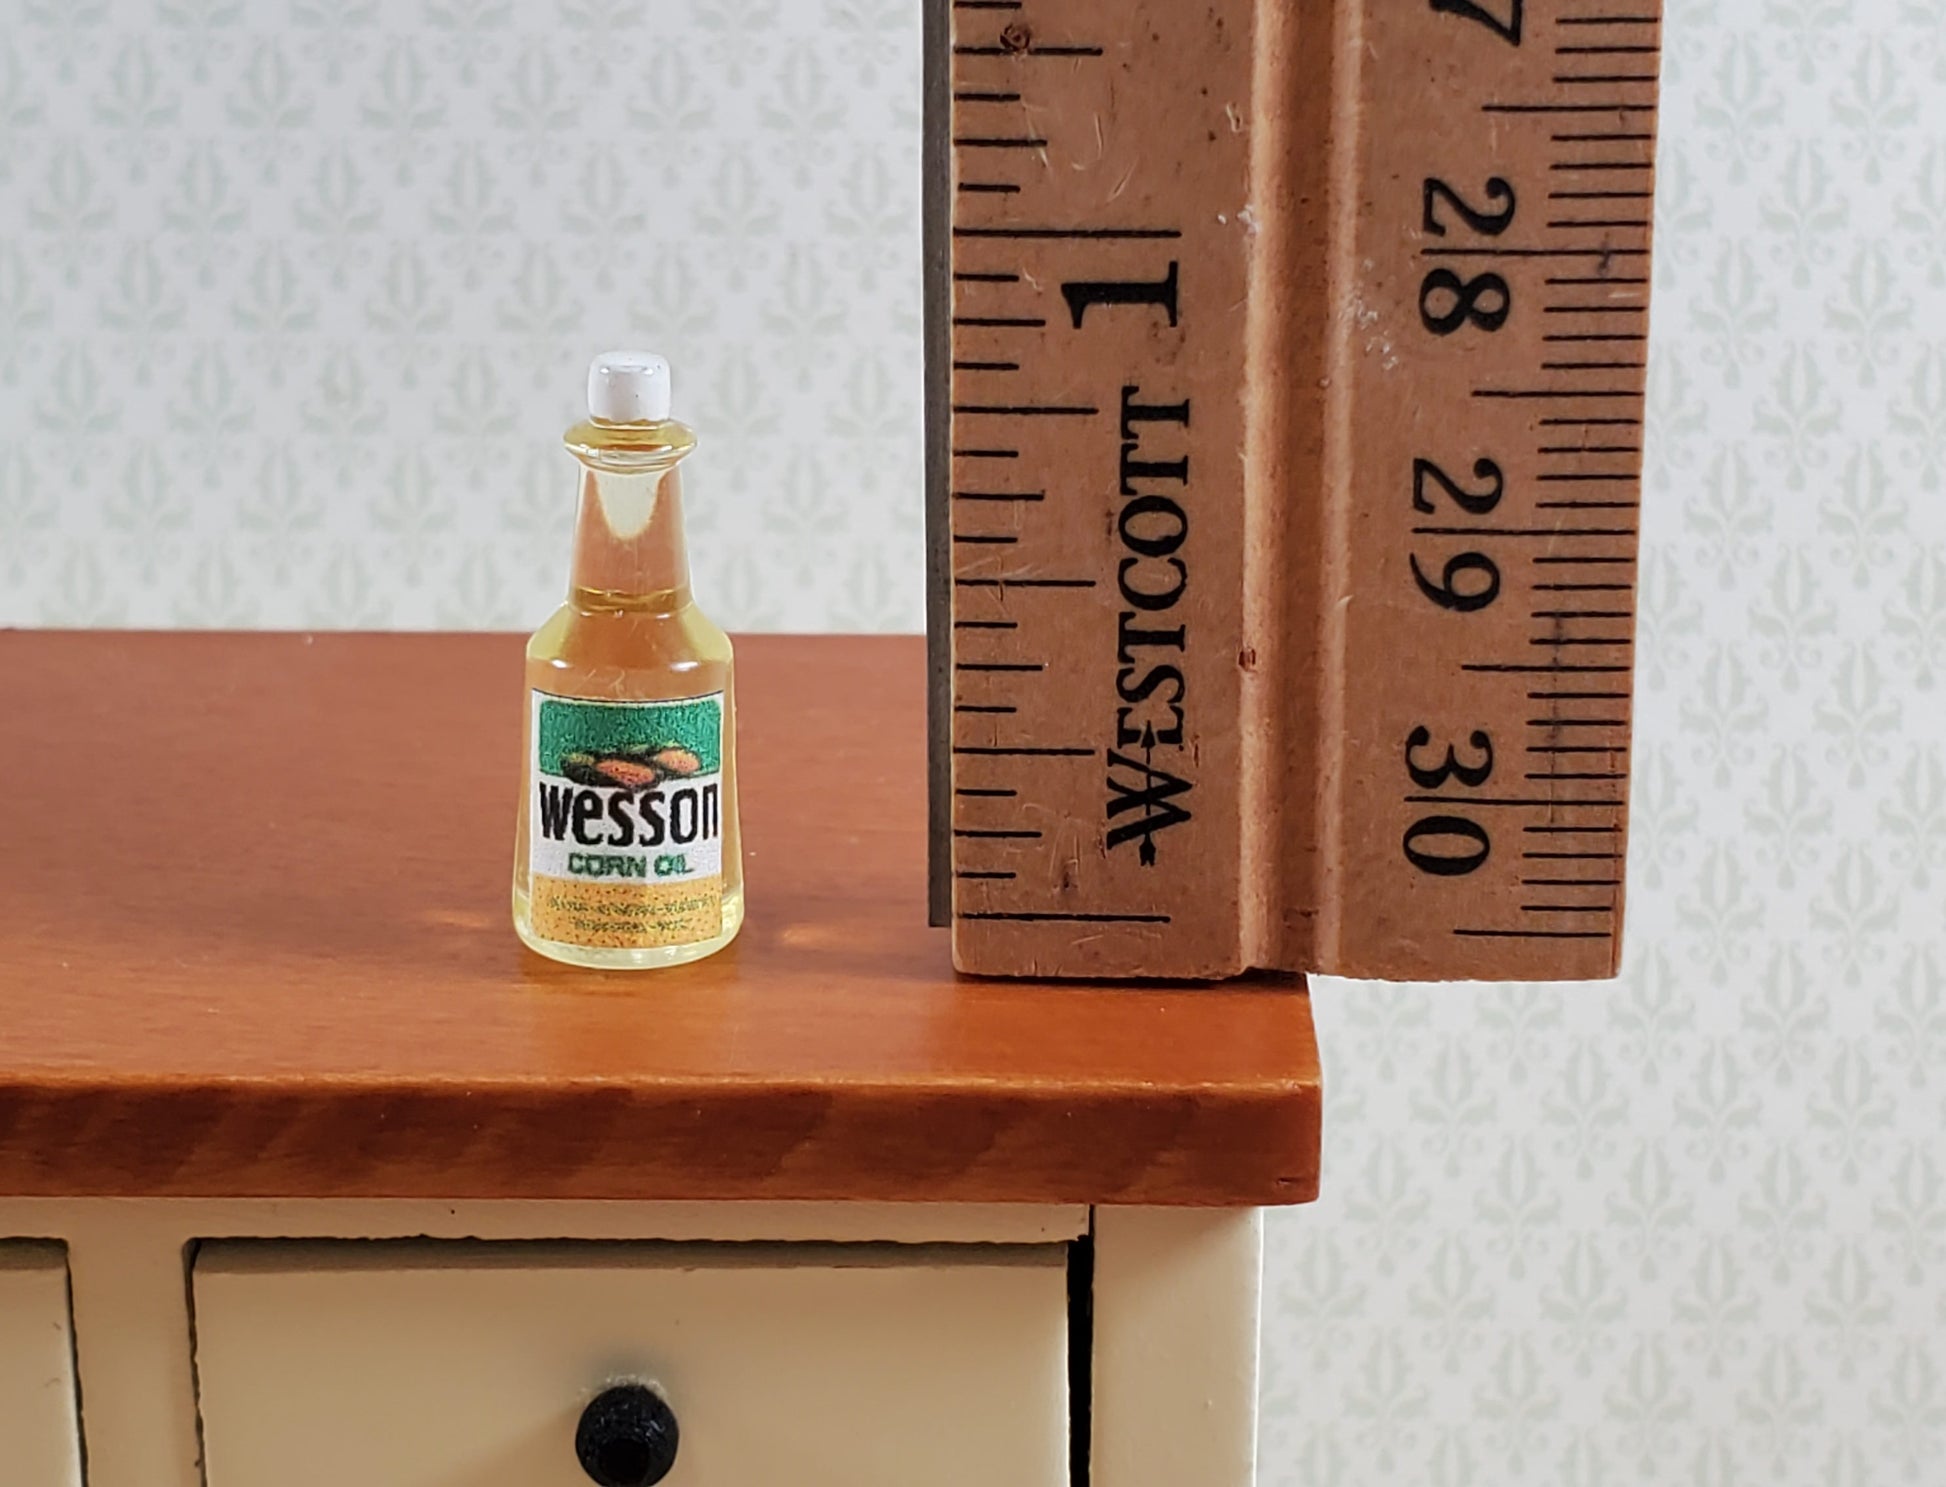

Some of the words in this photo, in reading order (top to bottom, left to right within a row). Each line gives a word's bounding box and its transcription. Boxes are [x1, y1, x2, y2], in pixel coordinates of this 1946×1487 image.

[1061, 260, 1179, 329] 1
[1419, 177, 1516, 336] 28
[1408, 457, 1504, 612] 29
[1107, 385, 1194, 849] WESTCOTT
[567, 853, 647, 877] CORN
[1402, 725, 1494, 876] 30
